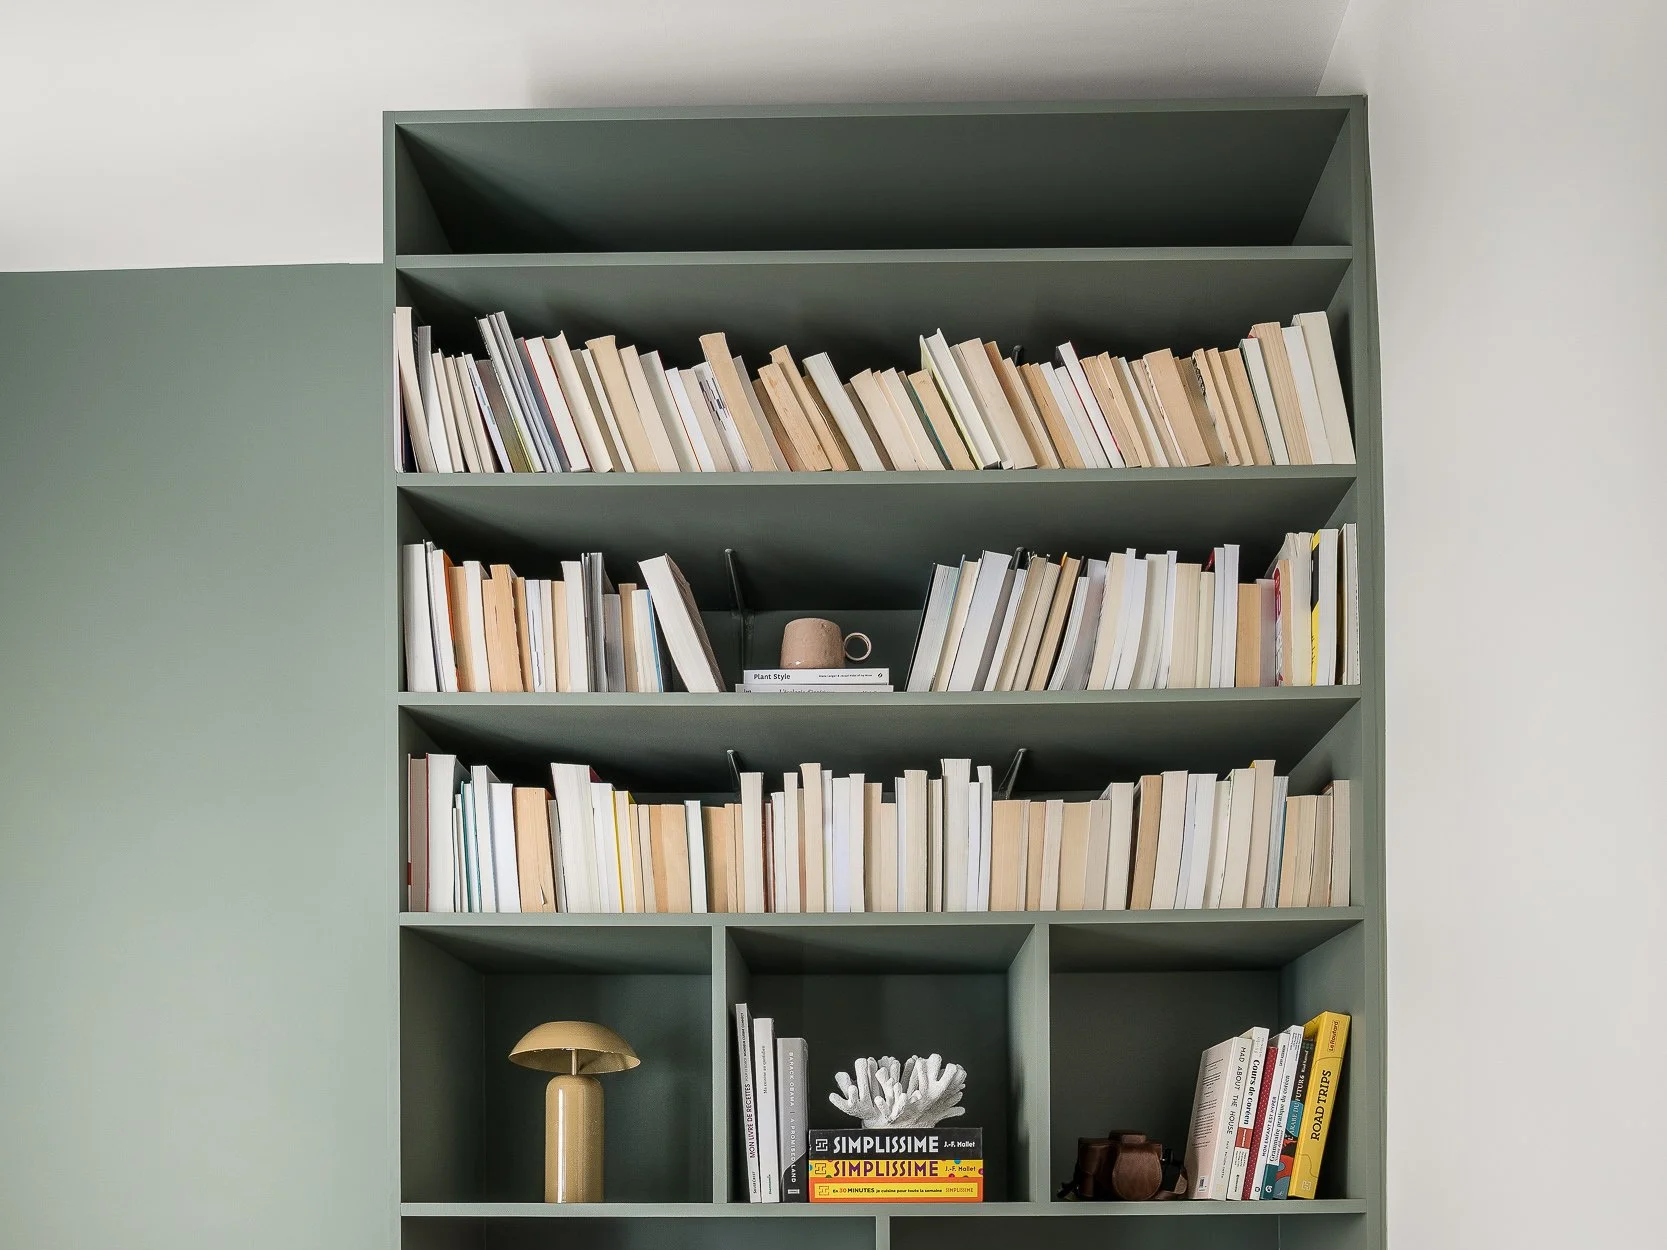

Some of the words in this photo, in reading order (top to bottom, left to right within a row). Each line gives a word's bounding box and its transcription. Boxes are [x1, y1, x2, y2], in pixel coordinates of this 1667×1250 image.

[1235, 1066, 1243, 1092] ABOUT
[1250, 1059, 1261, 1086] Cours
[1249, 1086, 1256, 1096] de
[1295, 1079, 1304, 1101] FUTUR
[747, 1113, 753, 1122] DE
[1243, 1096, 1253, 1125] coréen
[1294, 1102, 1299, 1112] DU
[1311, 1105, 1325, 1141] ROAD
[1318, 1070, 1331, 1104] TRIPS
[1226, 1110, 1236, 1135] HOUSE
[1269, 1129, 1281, 1162] Grammaire
[1276, 1103, 1285, 1128] pratique
[1281, 1075, 1290, 1094] coréen
[1287, 1113, 1298, 1140] L'ARABE
[834, 1136, 938, 1153] SIMPLISSIME
[834, 1161, 938, 1176] SIMPLISSIME
